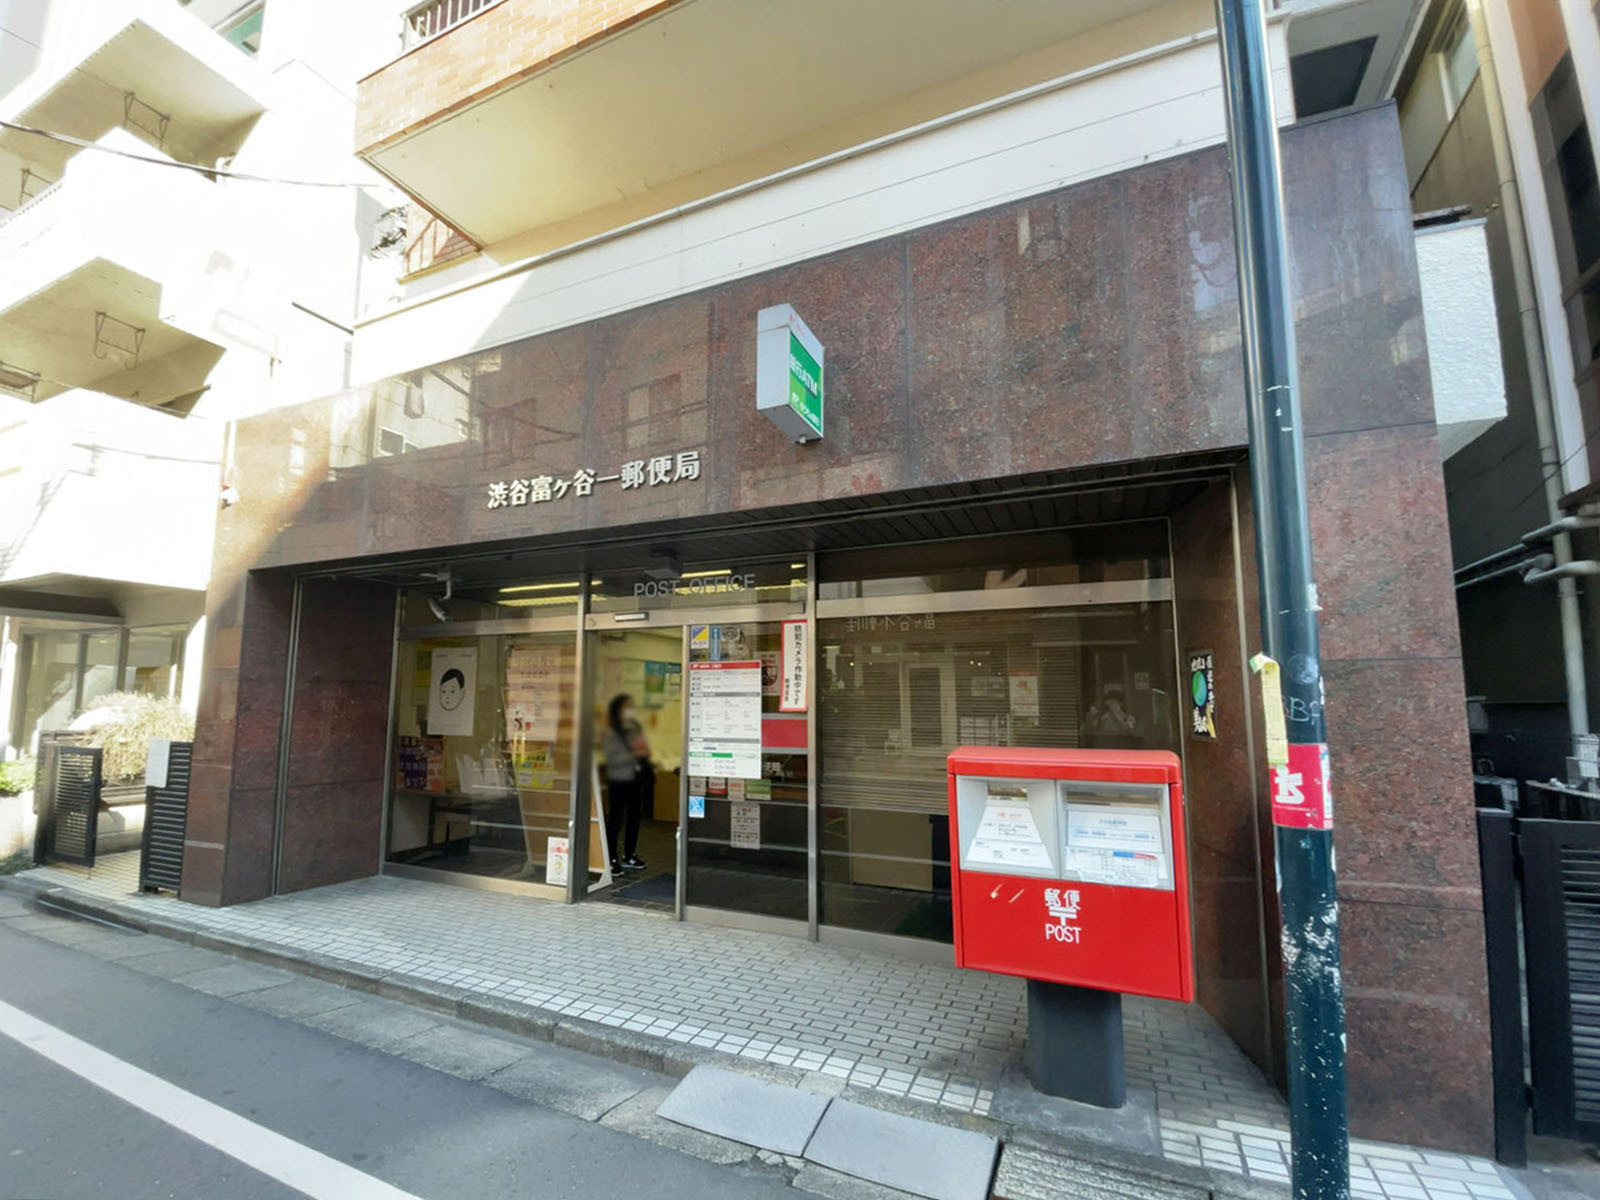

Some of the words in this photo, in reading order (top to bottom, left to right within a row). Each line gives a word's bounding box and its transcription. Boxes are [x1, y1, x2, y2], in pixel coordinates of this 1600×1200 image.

[634, 579, 680, 598] POST
[689, 573, 756, 595] OFFICE
[1044, 887, 1082, 911] 郵便
[1045, 922, 1082, 945] POST
